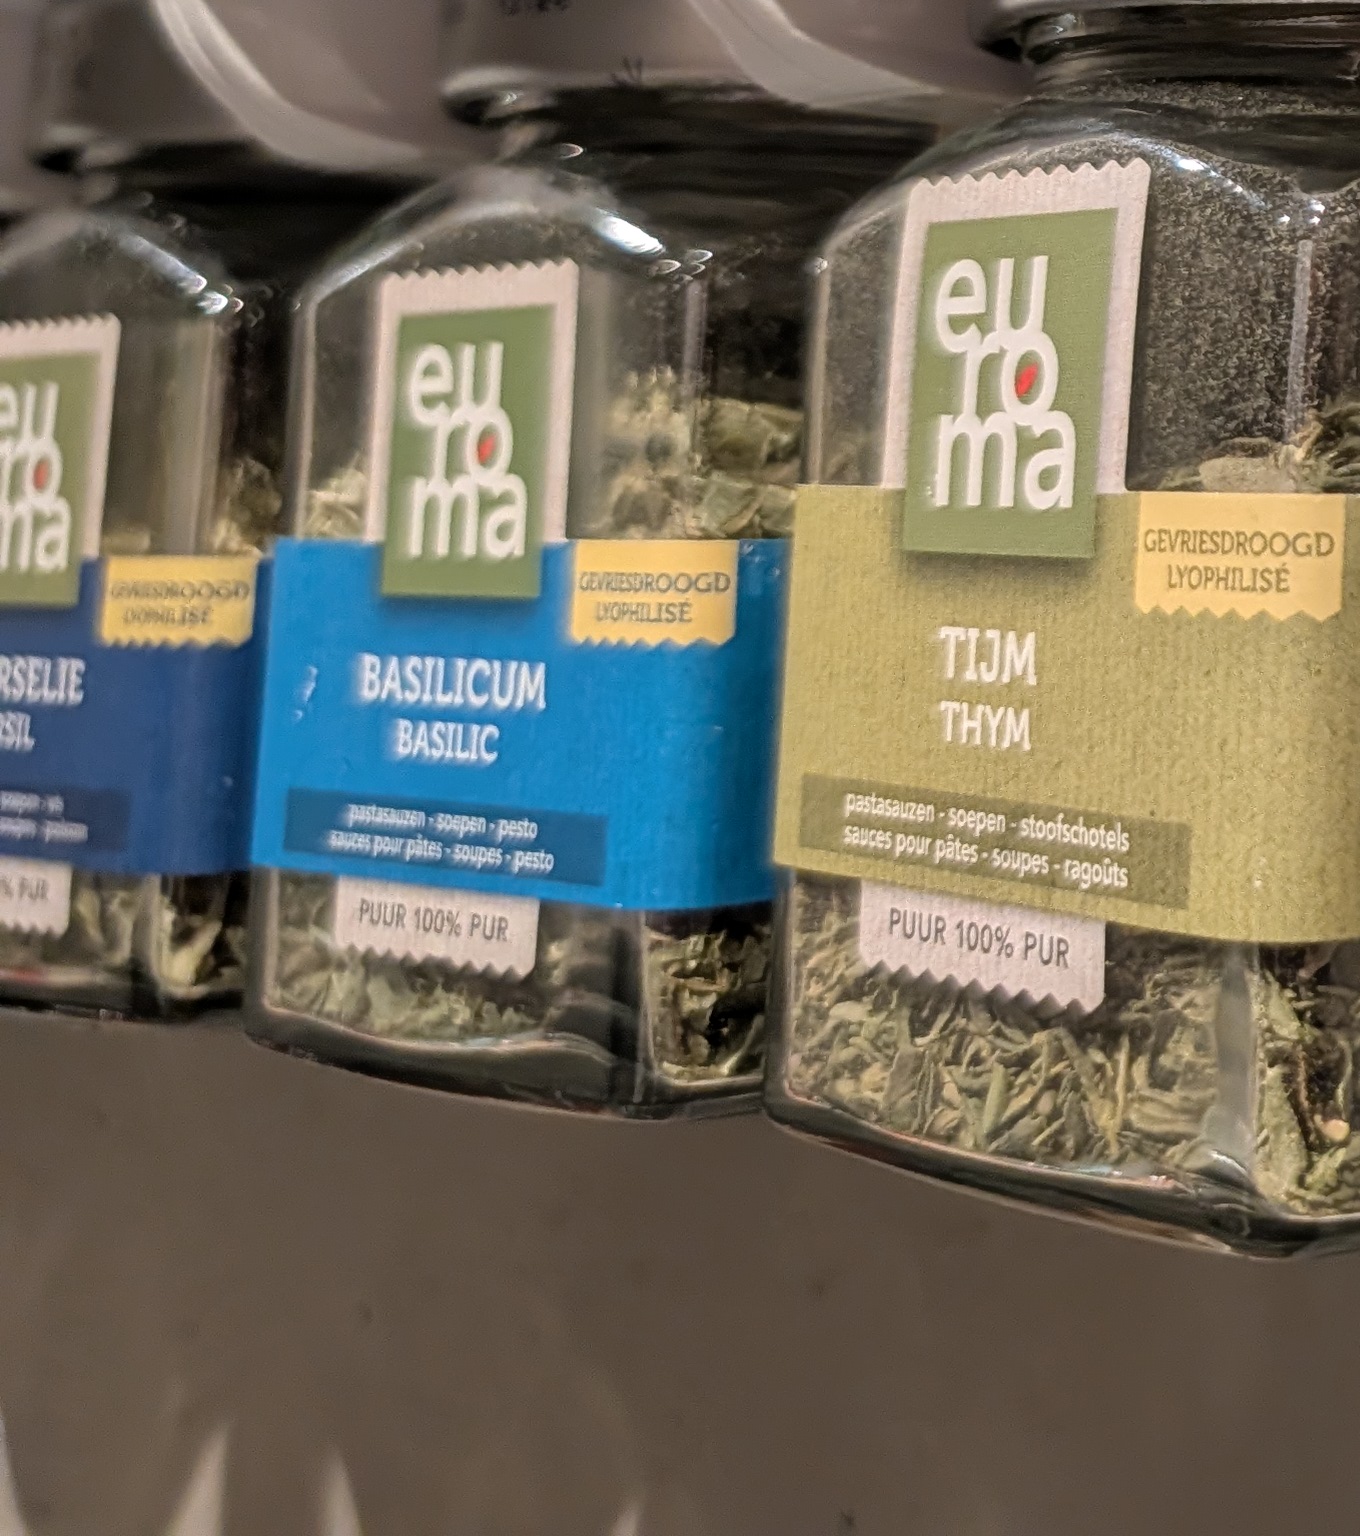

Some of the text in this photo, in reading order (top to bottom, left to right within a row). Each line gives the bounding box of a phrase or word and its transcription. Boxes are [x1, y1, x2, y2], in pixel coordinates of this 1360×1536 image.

[1143, 528, 1334, 558] GEVRIESDROOGD
[1166, 561, 1290, 592] LYOPHILISÉ
[938, 626, 1037, 686] TIJM
[357, 652, 546, 711] BASILICUM
[393, 718, 500, 764] BASILIC
[940, 701, 1031, 751] THYM
[497, 818, 538, 843] pesto
[844, 791, 935, 824] pastasauzen
[948, 807, 1006, 837] soepen
[1020, 812, 1130, 851] stoofschotels
[512, 849, 554, 875] pesto
[843, 824, 892, 852] sauces
[895, 832, 932, 858] pour
[934, 834, 978, 865] pâtes
[992, 847, 1049, 877] soupes
[1064, 857, 1128, 889] ragoûts
[358, 898, 509, 941] PUUR 100% PUR
[889, 907, 1070, 968] PUUR 100% PUR
